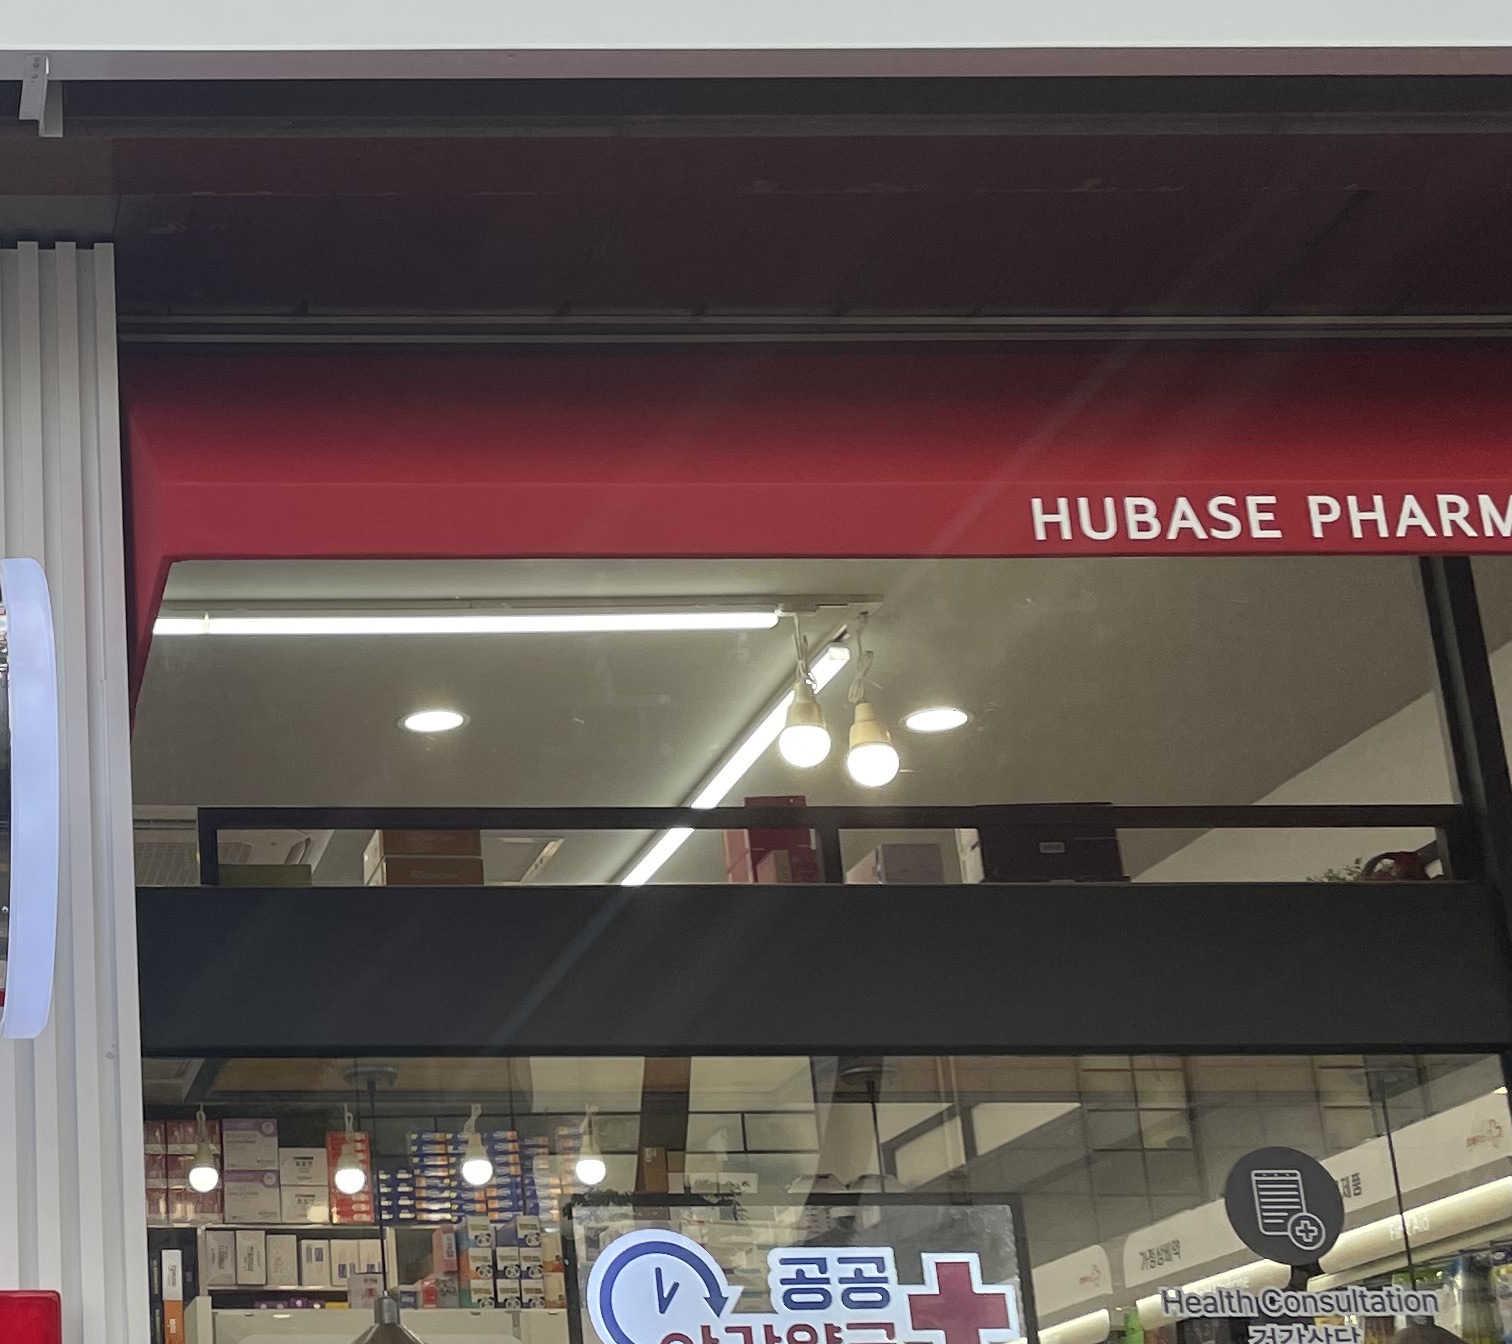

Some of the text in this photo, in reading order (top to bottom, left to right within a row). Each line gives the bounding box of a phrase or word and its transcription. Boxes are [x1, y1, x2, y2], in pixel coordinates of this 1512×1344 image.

[1031, 496, 1283, 540] HUBASE
[779, 1256, 892, 1311] 공공
[1162, 1286, 1439, 1315] Health Consultation
